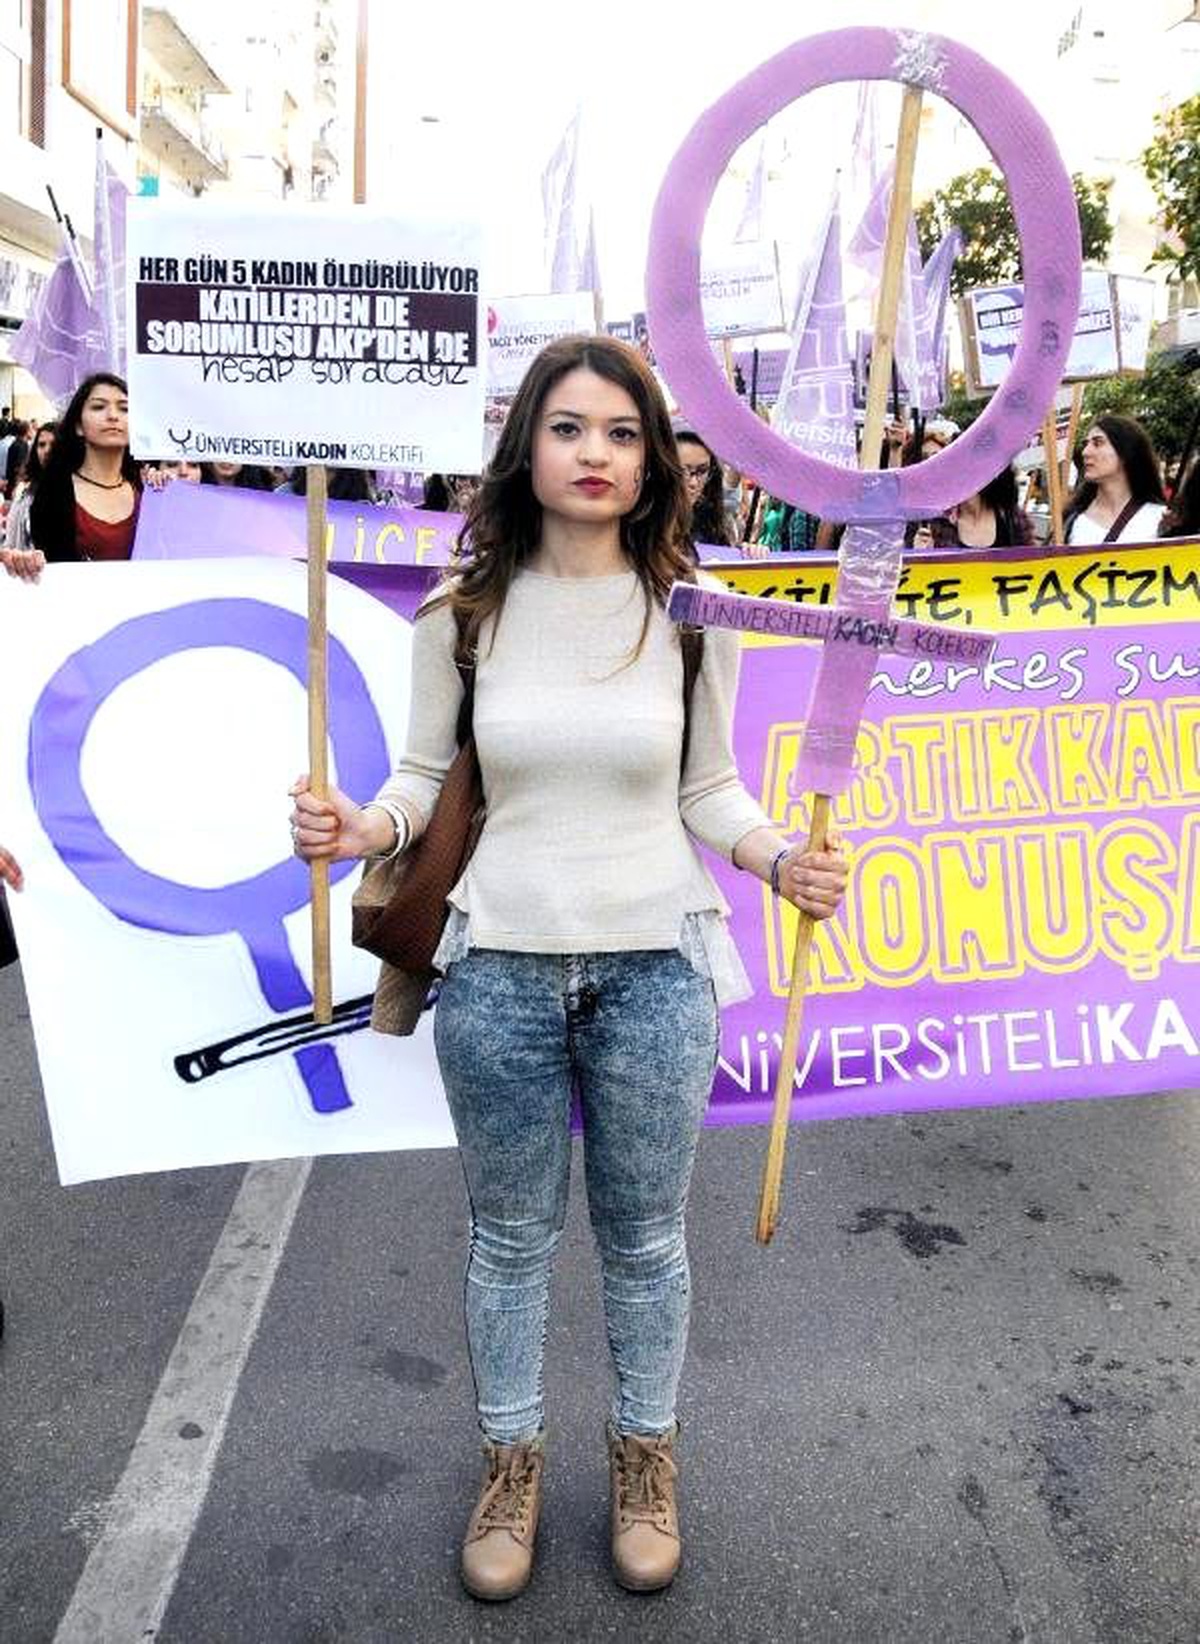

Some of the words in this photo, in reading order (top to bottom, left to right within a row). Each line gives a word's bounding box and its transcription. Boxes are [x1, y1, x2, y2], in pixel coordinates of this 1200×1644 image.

[139, 256, 179, 283] HER
[184, 254, 228, 284] GÜN
[232, 259, 246, 284] 5
[251, 261, 318, 287] KADIN
[323, 258, 479, 293] ÖLDÜRÜLÜYOR
[375, 295, 411, 328] DE
[147, 321, 312, 359] SORUMLUSU
[316, 327, 429, 362] AKP'DEN
[436, 332, 469, 364] DE
[202, 354, 296, 384] hesap
[296, 441, 348, 460] KADIN
[834, 614, 899, 649] KADIN
